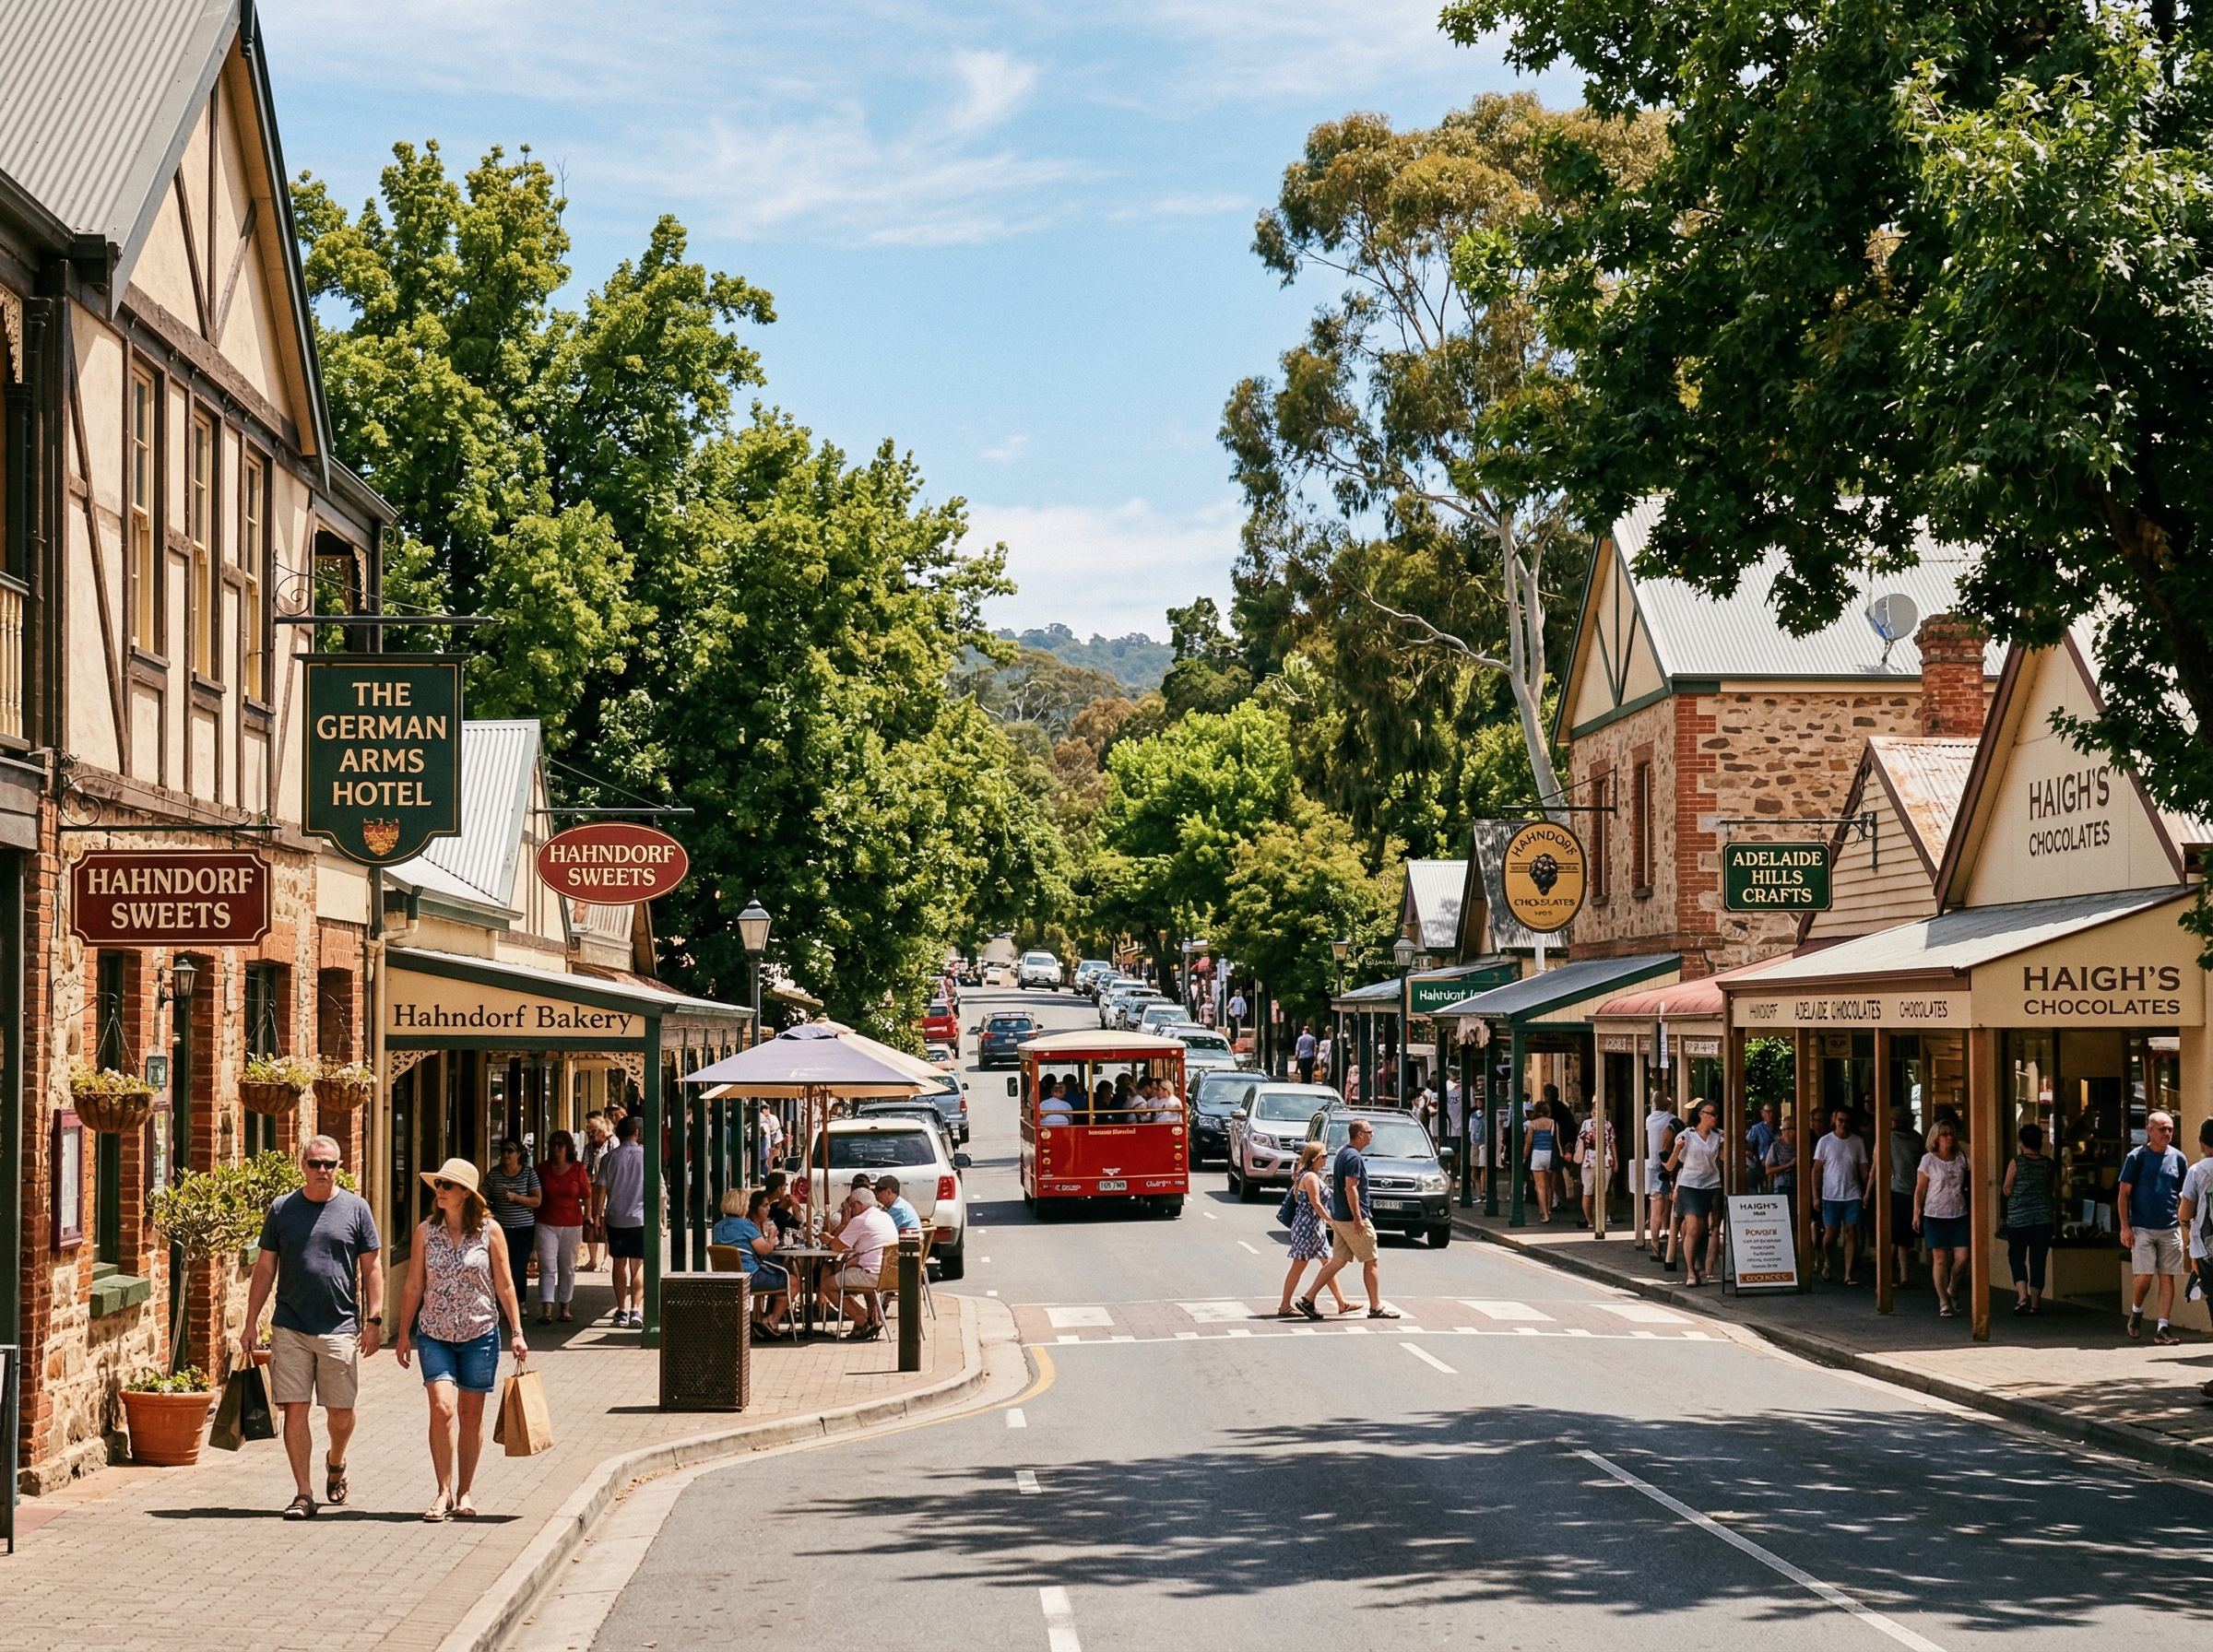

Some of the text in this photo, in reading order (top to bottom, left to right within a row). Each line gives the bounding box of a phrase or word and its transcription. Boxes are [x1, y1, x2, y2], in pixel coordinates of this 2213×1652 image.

[352, 682, 411, 707] THE
[317, 714, 447, 741] GERMAN
[338, 748, 425, 773] ARMS
[332, 781, 432, 807] HOTEL
[2029, 765, 2111, 821] HAIGH'S
[2029, 820, 2111, 857] CHOCOLATES
[549, 844, 676, 864] HAHNDORF
[1732, 851, 1823, 867] ADELAIDE
[88, 867, 254, 895] HAHNDORF
[567, 867, 657, 887] SWEETS
[1751, 869, 1804, 885] HILLS
[1742, 887, 1813, 904] CRAFTS
[111, 901, 231, 929] SWEETS
[2023, 965, 2181, 993] HAIGH'S
[394, 1004, 633, 1034] Hahndorf Bakery
[2023, 998, 2181, 1015] CHOCOLATES
